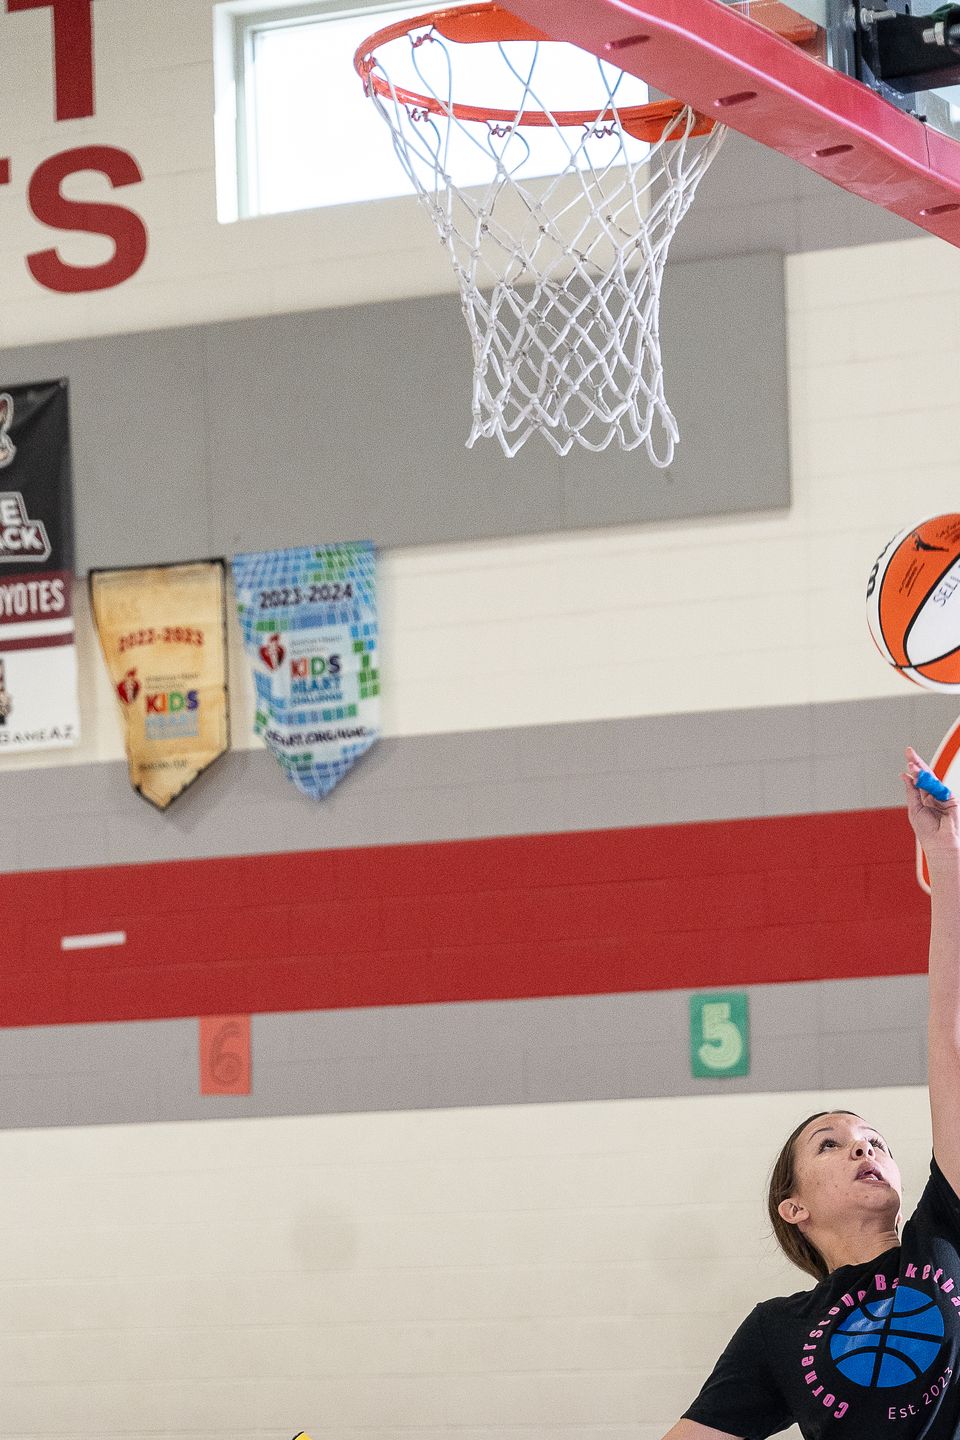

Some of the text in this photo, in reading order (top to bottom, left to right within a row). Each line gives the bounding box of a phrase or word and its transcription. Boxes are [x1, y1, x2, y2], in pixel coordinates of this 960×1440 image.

[291, 655, 341, 680] KIDS
[146, 690, 199, 715] KIDS
[208, 1021, 242, 1087] 6
[699, 1002, 741, 1069] 5
[888, 1366, 953, 1420] Est. 2023
